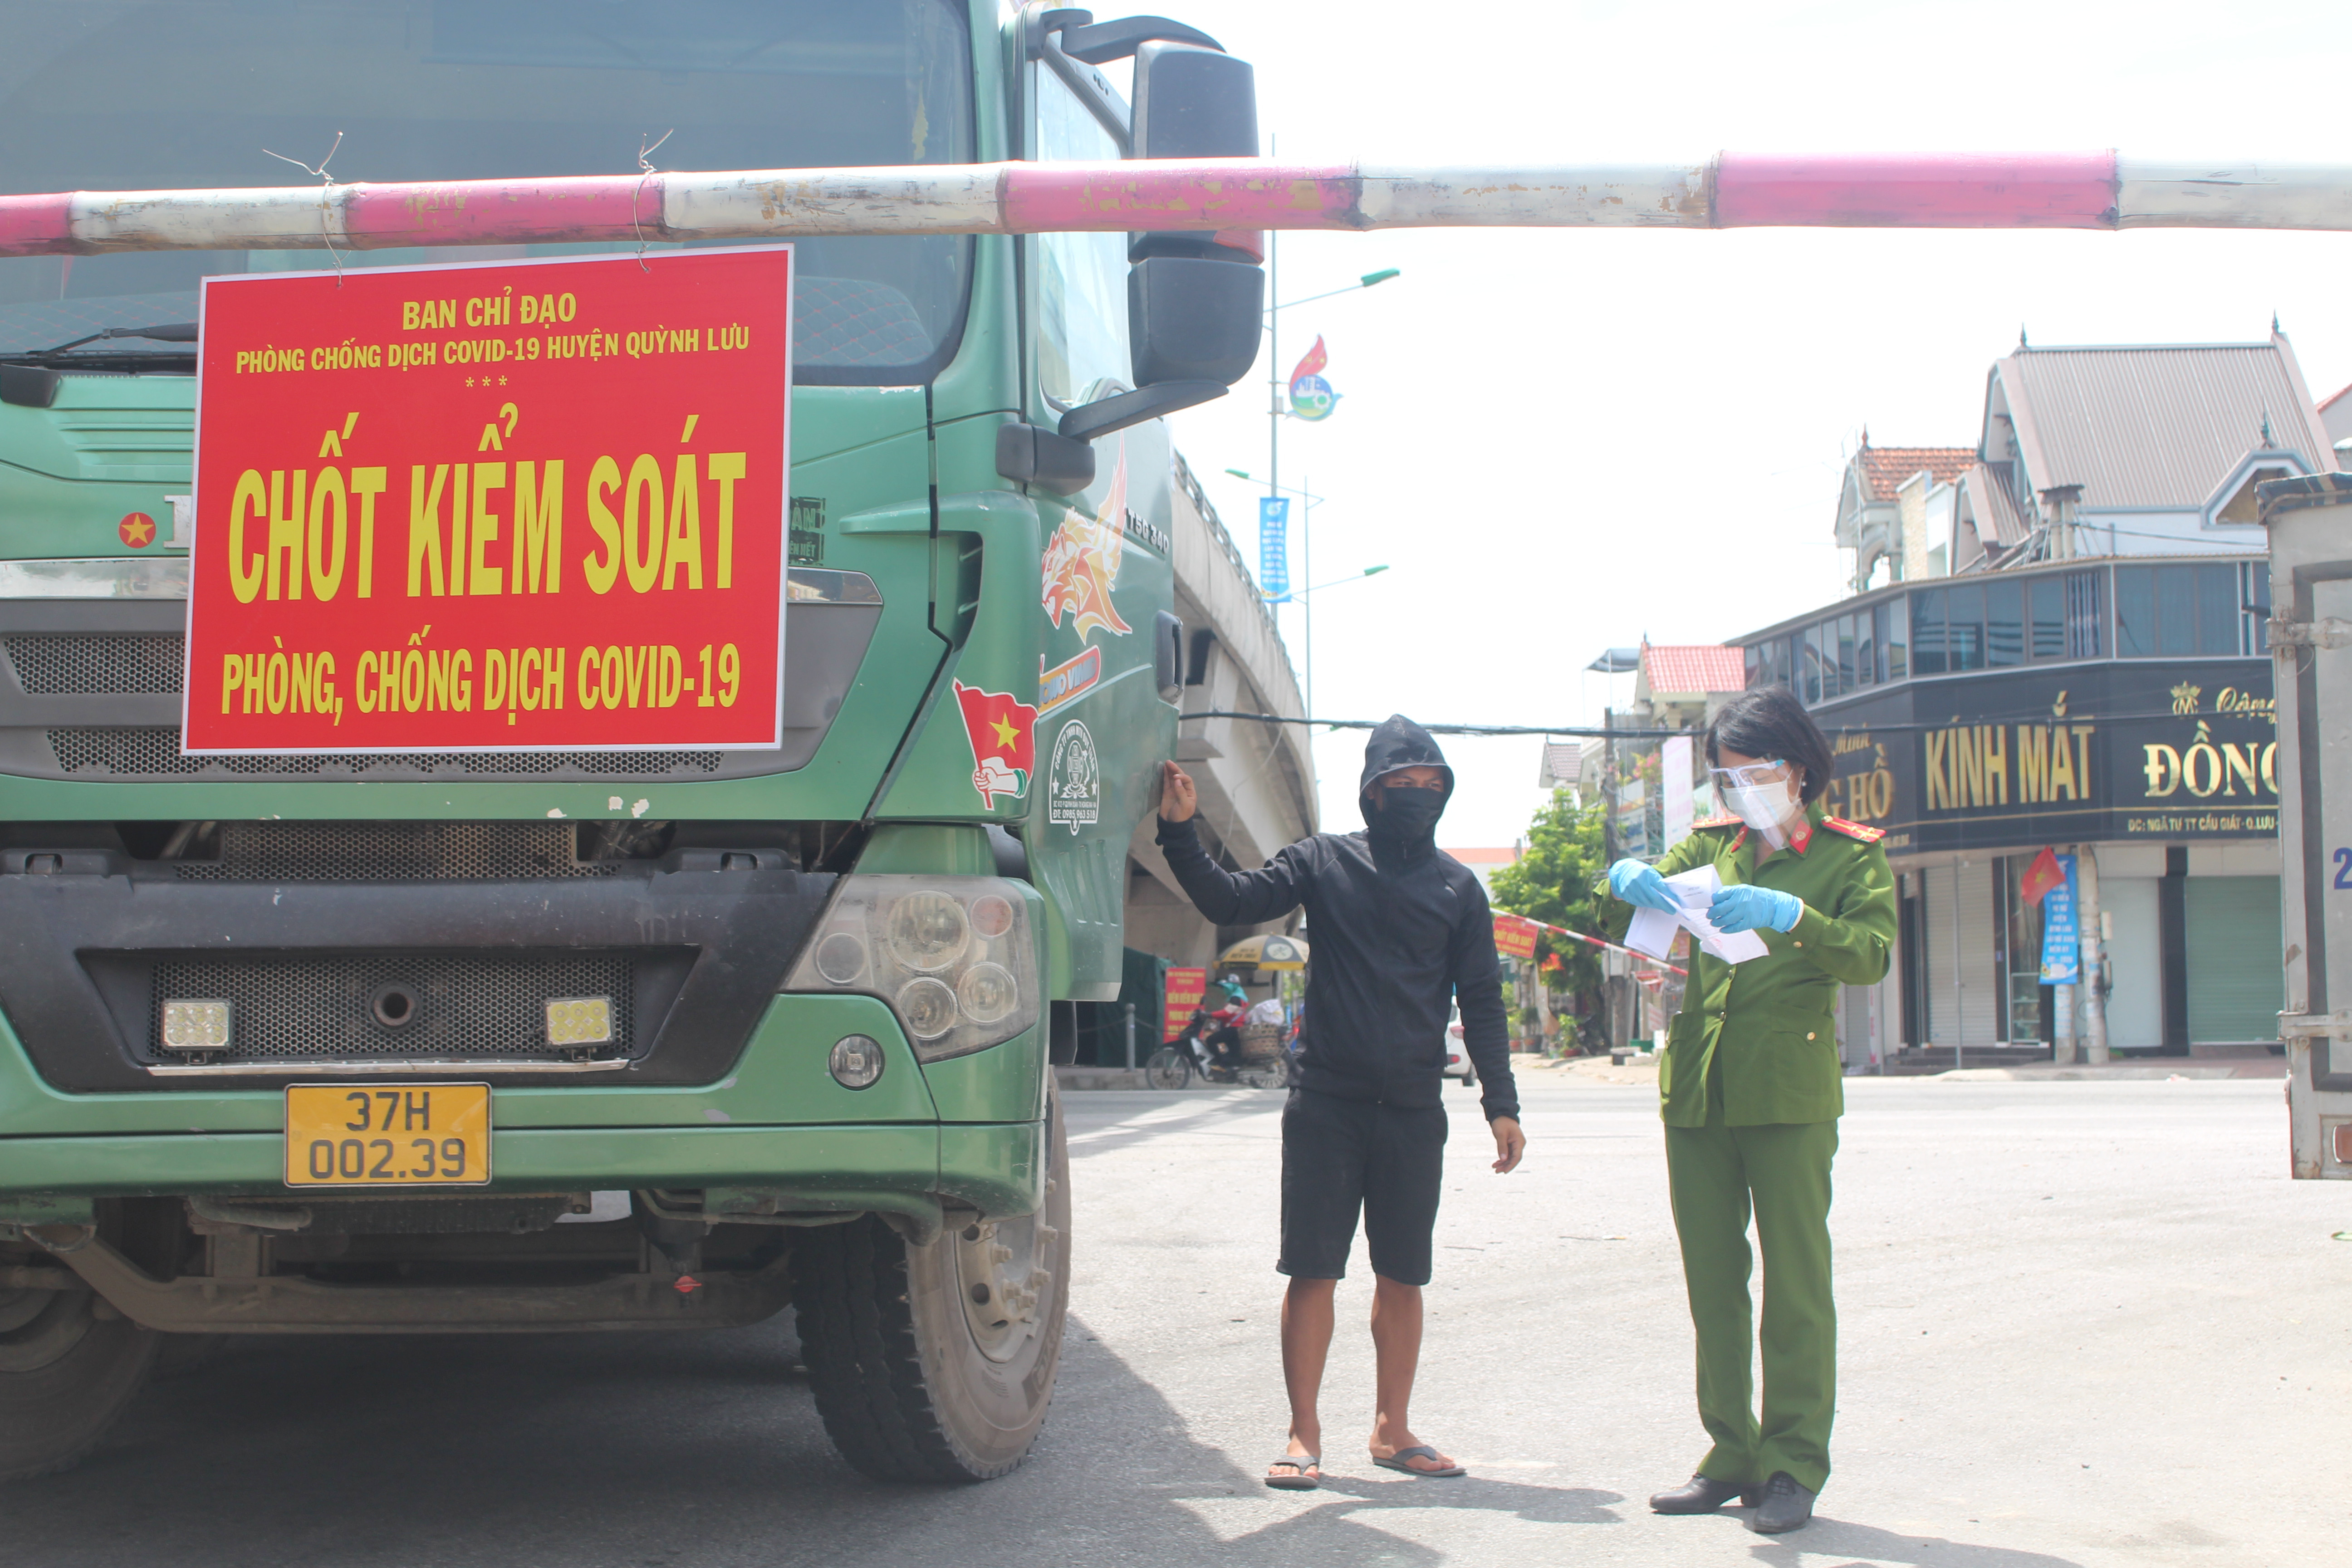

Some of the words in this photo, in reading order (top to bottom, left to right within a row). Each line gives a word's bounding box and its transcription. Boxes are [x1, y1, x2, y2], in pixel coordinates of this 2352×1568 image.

[403, 299, 456, 330] BAN
[466, 286, 512, 327] CHỈ
[520, 292, 577, 329] ĐẠO
[236, 344, 304, 374] PHÒNG
[311, 338, 381, 370] CHỐNG
[402, 342, 436, 372] DỊCH
[444, 337, 539, 364] COVID-19
[547, 327, 619, 361] HUYỆN
[626, 324, 699, 359] QUỲNH
[708, 323, 750, 350] LƯU
[229, 412, 387, 604] CHỐT
[407, 402, 564, 597] KIỂM
[583, 415, 746, 595] SOÁT
[1127, 507, 1149, 540] T5G
[1149, 524, 1170, 554] 340
[222, 636, 343, 726] PHÒNG,
[356, 624, 472, 713] CHỐNG
[484, 648, 565, 725] DỊCH
[578, 643, 740, 710] COVID-19
[1926, 715, 2009, 811] KÍNH
[2018, 690, 2096, 804] MẮT
[1847, 743, 1895, 822] HỒ
[1062, 809, 1075, 819] 0985
[1076, 809, 1086, 819] 963
[1086, 810, 1096, 819] 518
[2185, 818, 2197, 831] TT
[346, 1091, 430, 1132] 37H
[309, 1137, 466, 1180] 002.39
